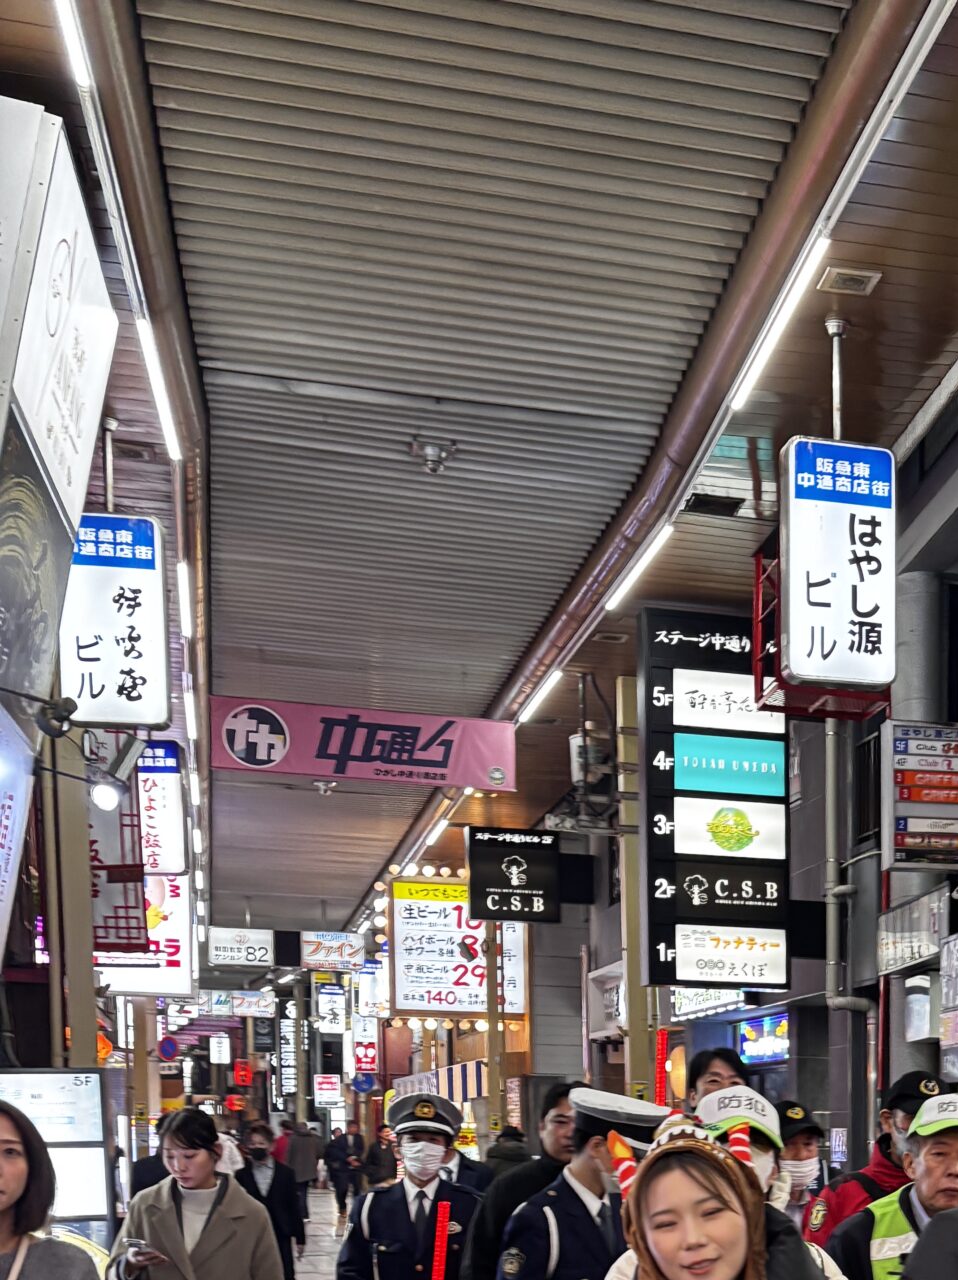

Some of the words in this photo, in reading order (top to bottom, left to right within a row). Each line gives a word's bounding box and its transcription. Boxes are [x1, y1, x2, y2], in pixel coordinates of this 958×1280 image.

[815, 457, 871, 478] 阪急東
[796, 472, 890, 497] 中通商店街
[74, 542, 153, 561] 通商店街
[848, 512, 883, 657] はやし源
[805, 569, 838, 662] ビル
[654, 630, 778, 654] ステージ中通りル
[76, 634, 106, 699] ビル
[652, 686, 674, 707] 5F
[653, 750, 675, 771] 4F
[140, 777, 163, 870] ひよこ飯店
[653, 814, 675, 835] 3F
[654, 878, 676, 898] 2F
[714, 878, 778, 899] C.S.B
[402, 904, 450, 921] 生ビール
[486, 894, 545, 912] C.S.B
[245, 946, 269, 963] 82
[656, 942, 676, 962] 1F
[425, 990, 458, 1005] 140
